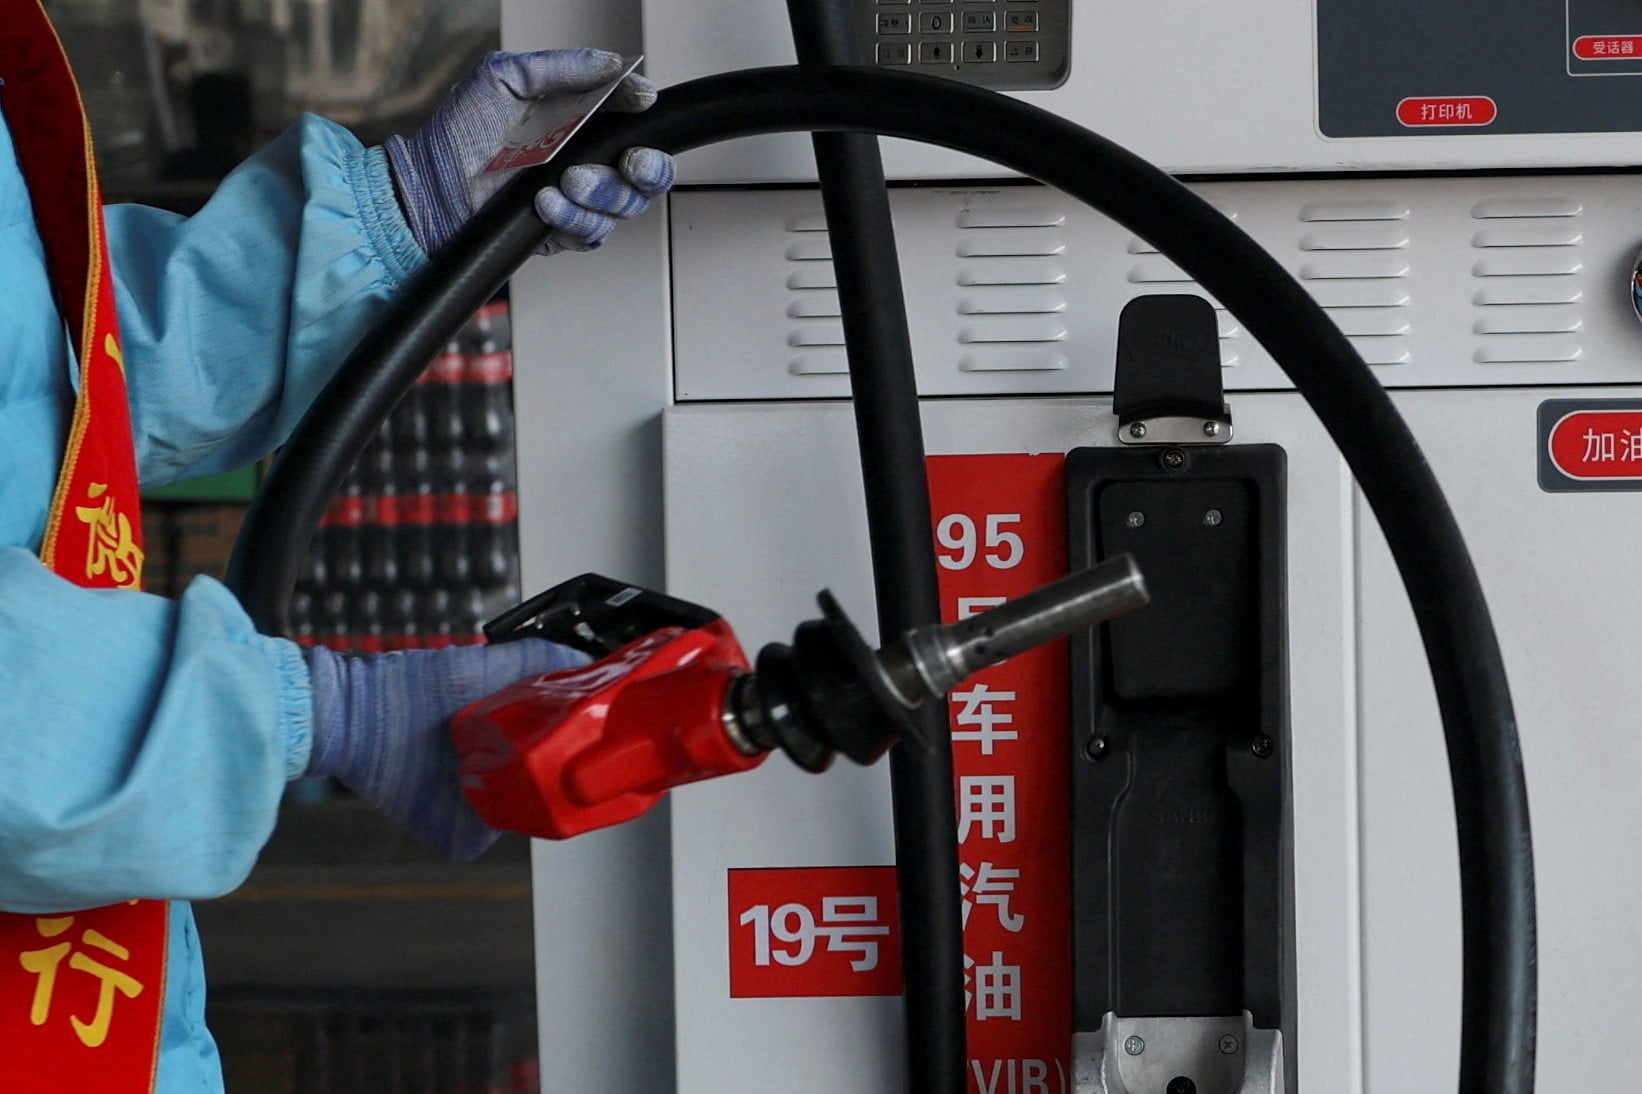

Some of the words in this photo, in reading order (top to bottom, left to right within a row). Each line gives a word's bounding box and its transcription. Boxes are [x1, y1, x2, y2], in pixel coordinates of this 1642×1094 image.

[932, 15, 942, 30] 0
[1592, 40, 1635, 55] 受话器
[1421, 103, 1473, 120] 打印机
[937, 513, 1025, 1020] 95车用汽油
[738, 895, 890, 971] 19号
[19, 915, 145, 1048] 行
